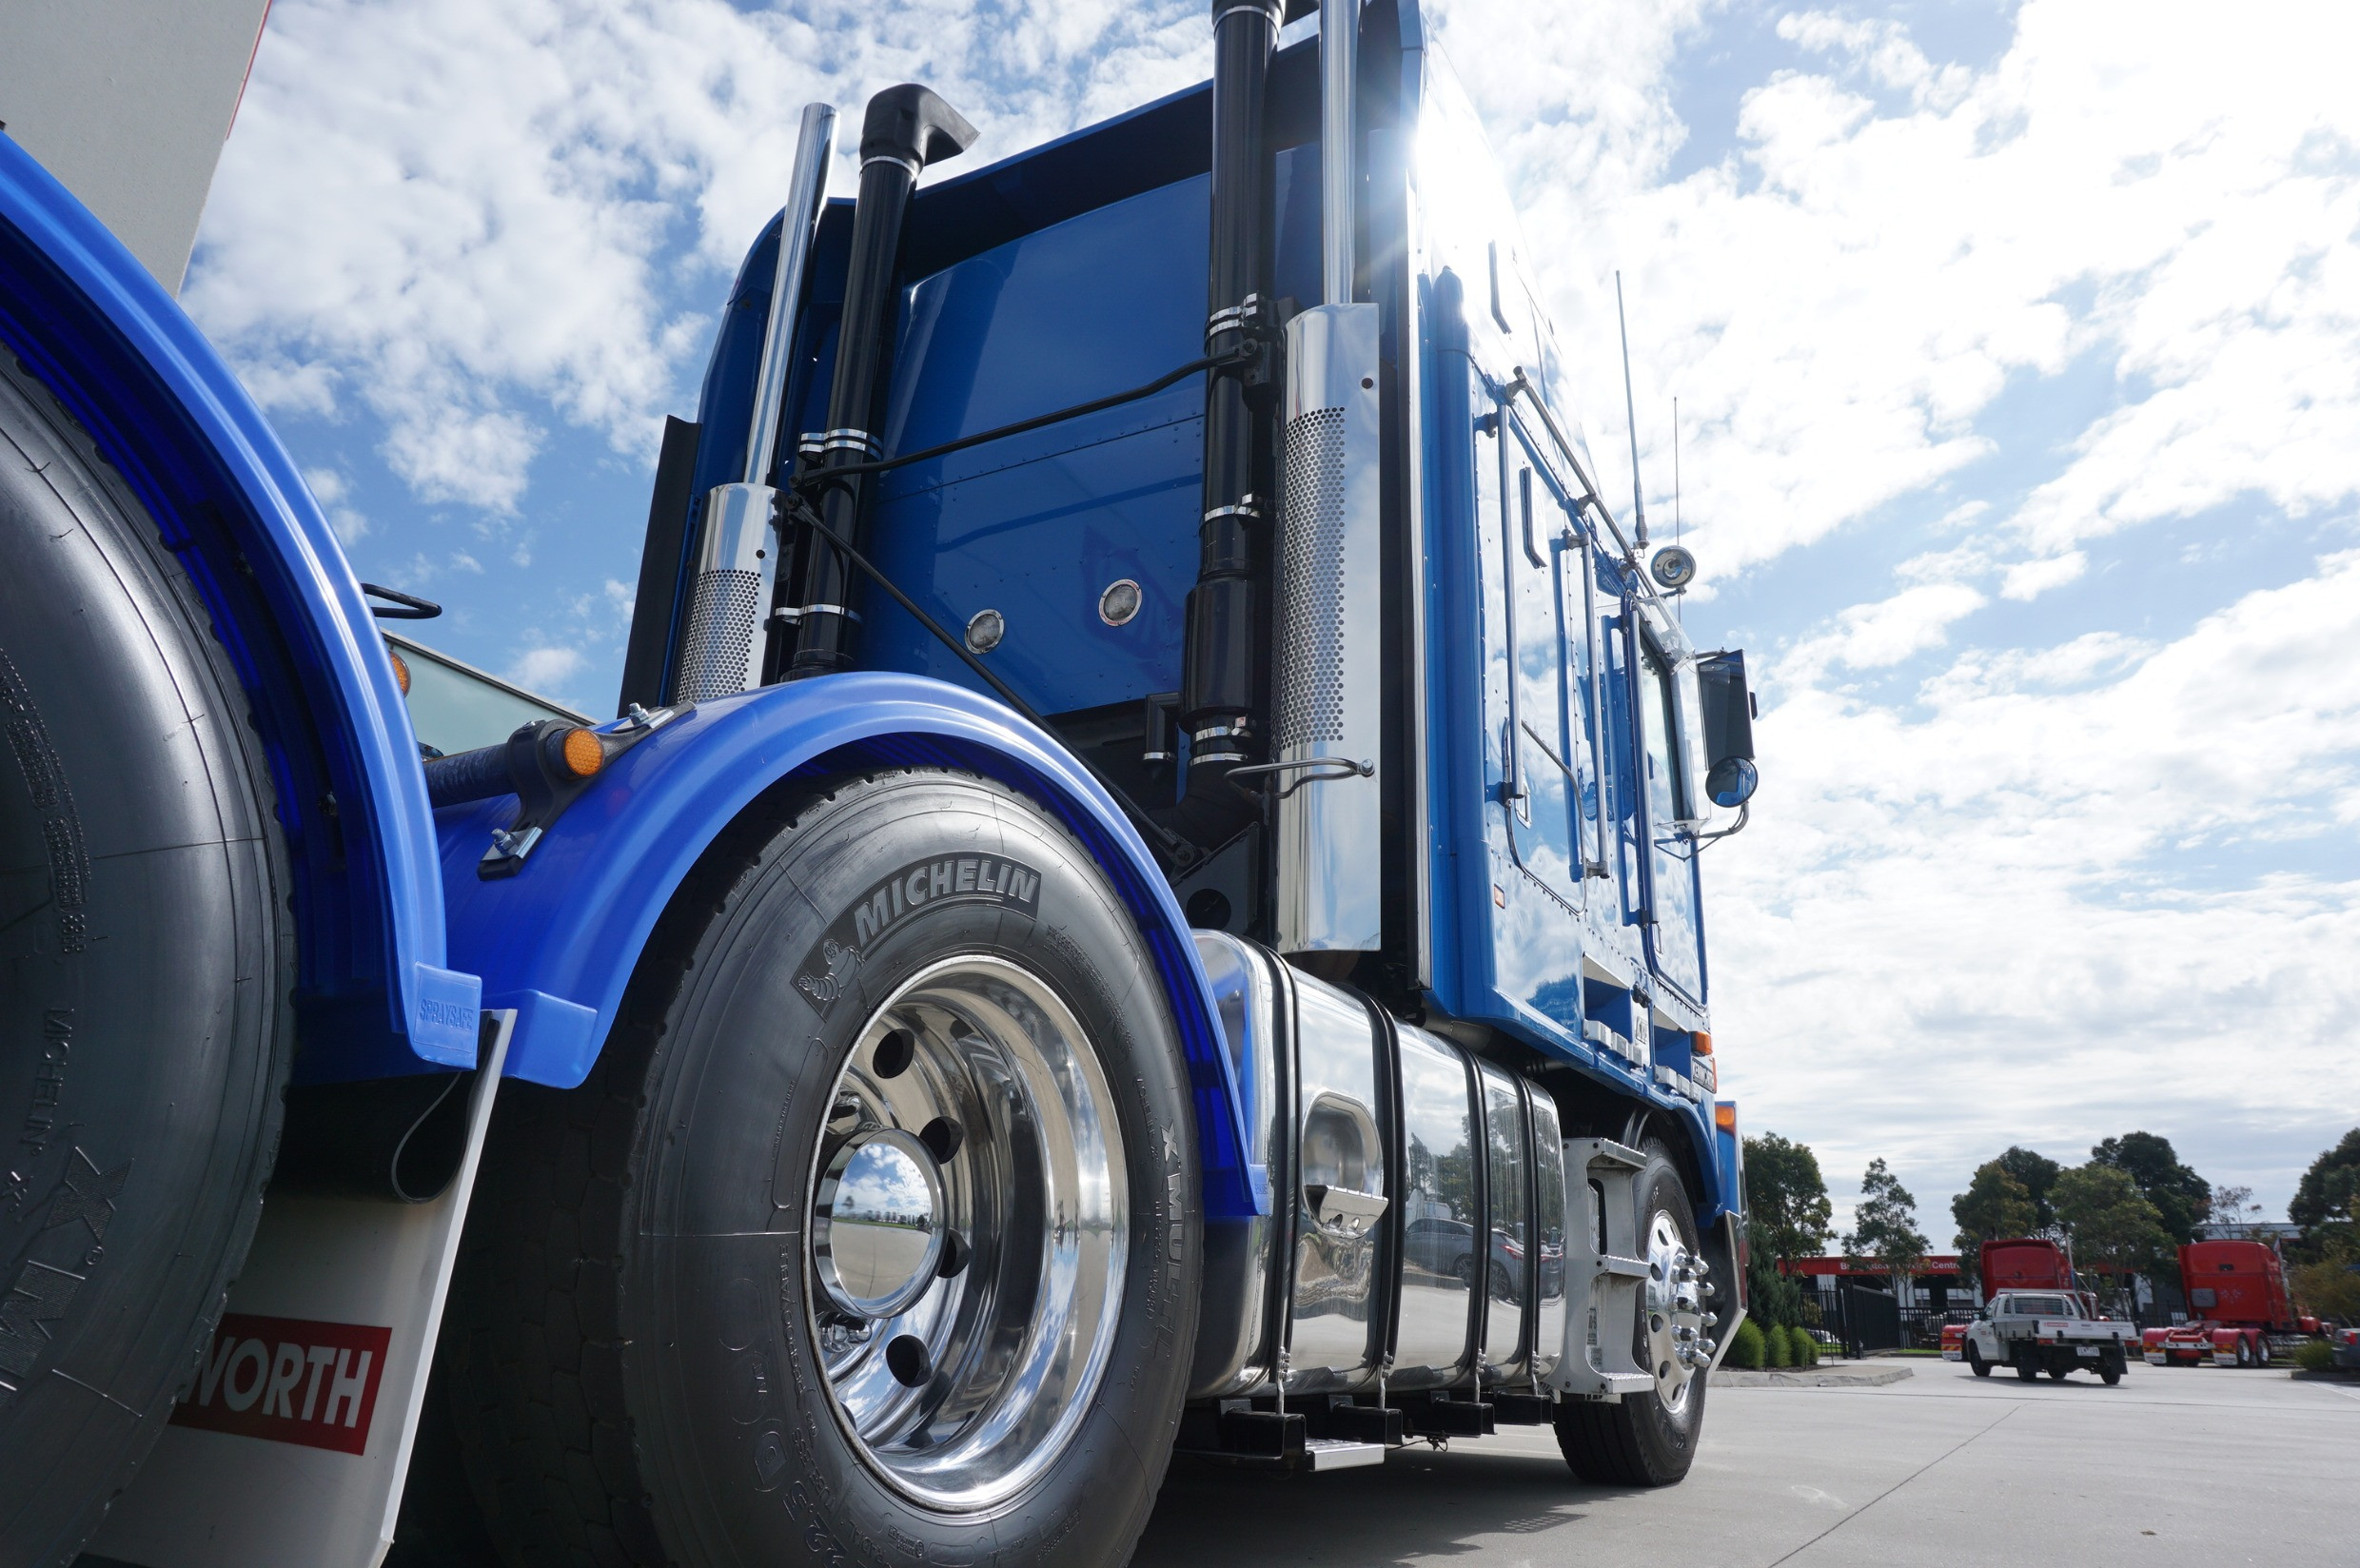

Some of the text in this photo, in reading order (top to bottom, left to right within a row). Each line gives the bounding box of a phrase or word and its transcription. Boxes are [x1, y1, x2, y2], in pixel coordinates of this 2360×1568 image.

[854, 860, 1038, 949] MICHELIN
[419, 997, 474, 1030] SPRAYSAFE
[26, 1008, 75, 1146] MICHELIN
